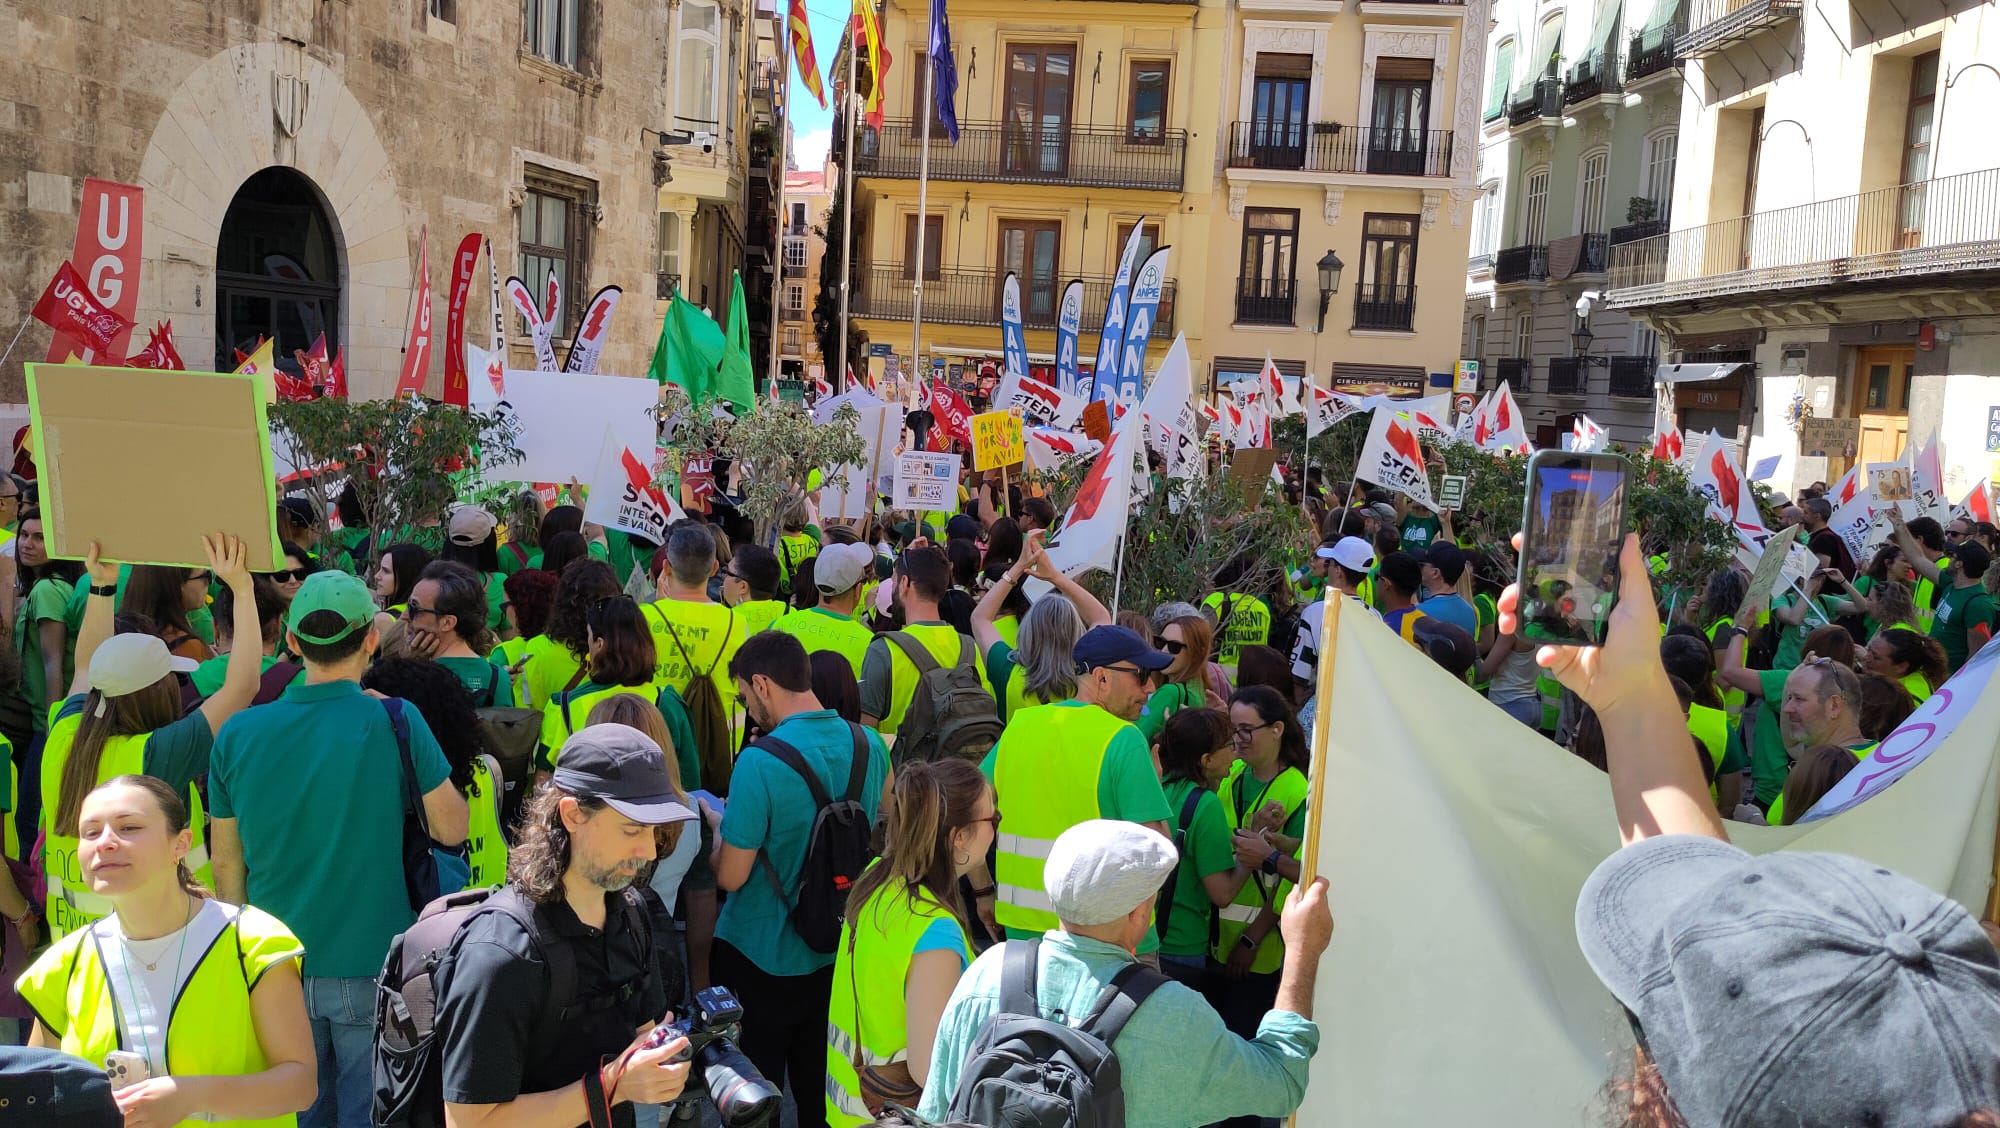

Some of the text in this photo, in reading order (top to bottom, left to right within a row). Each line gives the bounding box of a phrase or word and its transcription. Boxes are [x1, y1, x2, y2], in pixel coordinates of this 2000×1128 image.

[82, 192, 130, 365] UG
[54, 278, 97, 316] UGT
[1136, 287, 1160, 298] ANPE
[566, 340, 587, 374] EPV
[1011, 394, 1061, 423] STEPV
[1417, 427, 1447, 440] STEPV
[686, 459, 713, 474] AL
[652, 620, 710, 642] OCENT
[669, 641, 696, 658] EN
